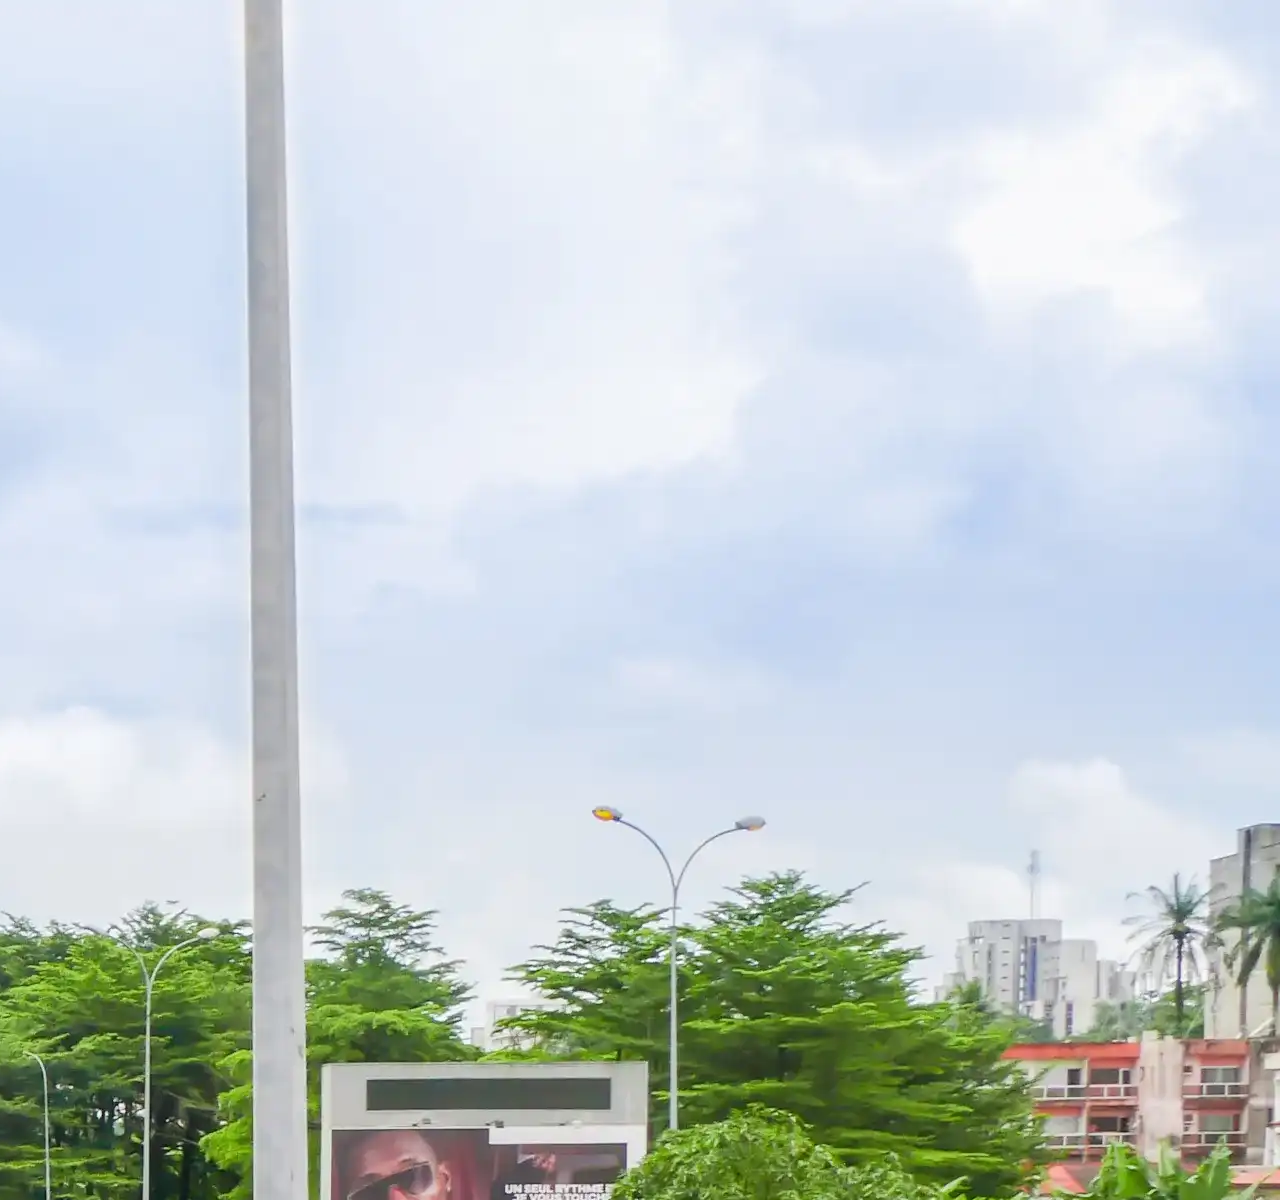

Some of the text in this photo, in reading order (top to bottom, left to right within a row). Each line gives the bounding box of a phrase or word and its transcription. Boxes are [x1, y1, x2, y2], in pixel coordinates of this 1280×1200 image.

[505, 1184, 522, 1194] UN
[523, 1184, 554, 1193] SEUL
[555, 1184, 604, 1193] RYTHME
